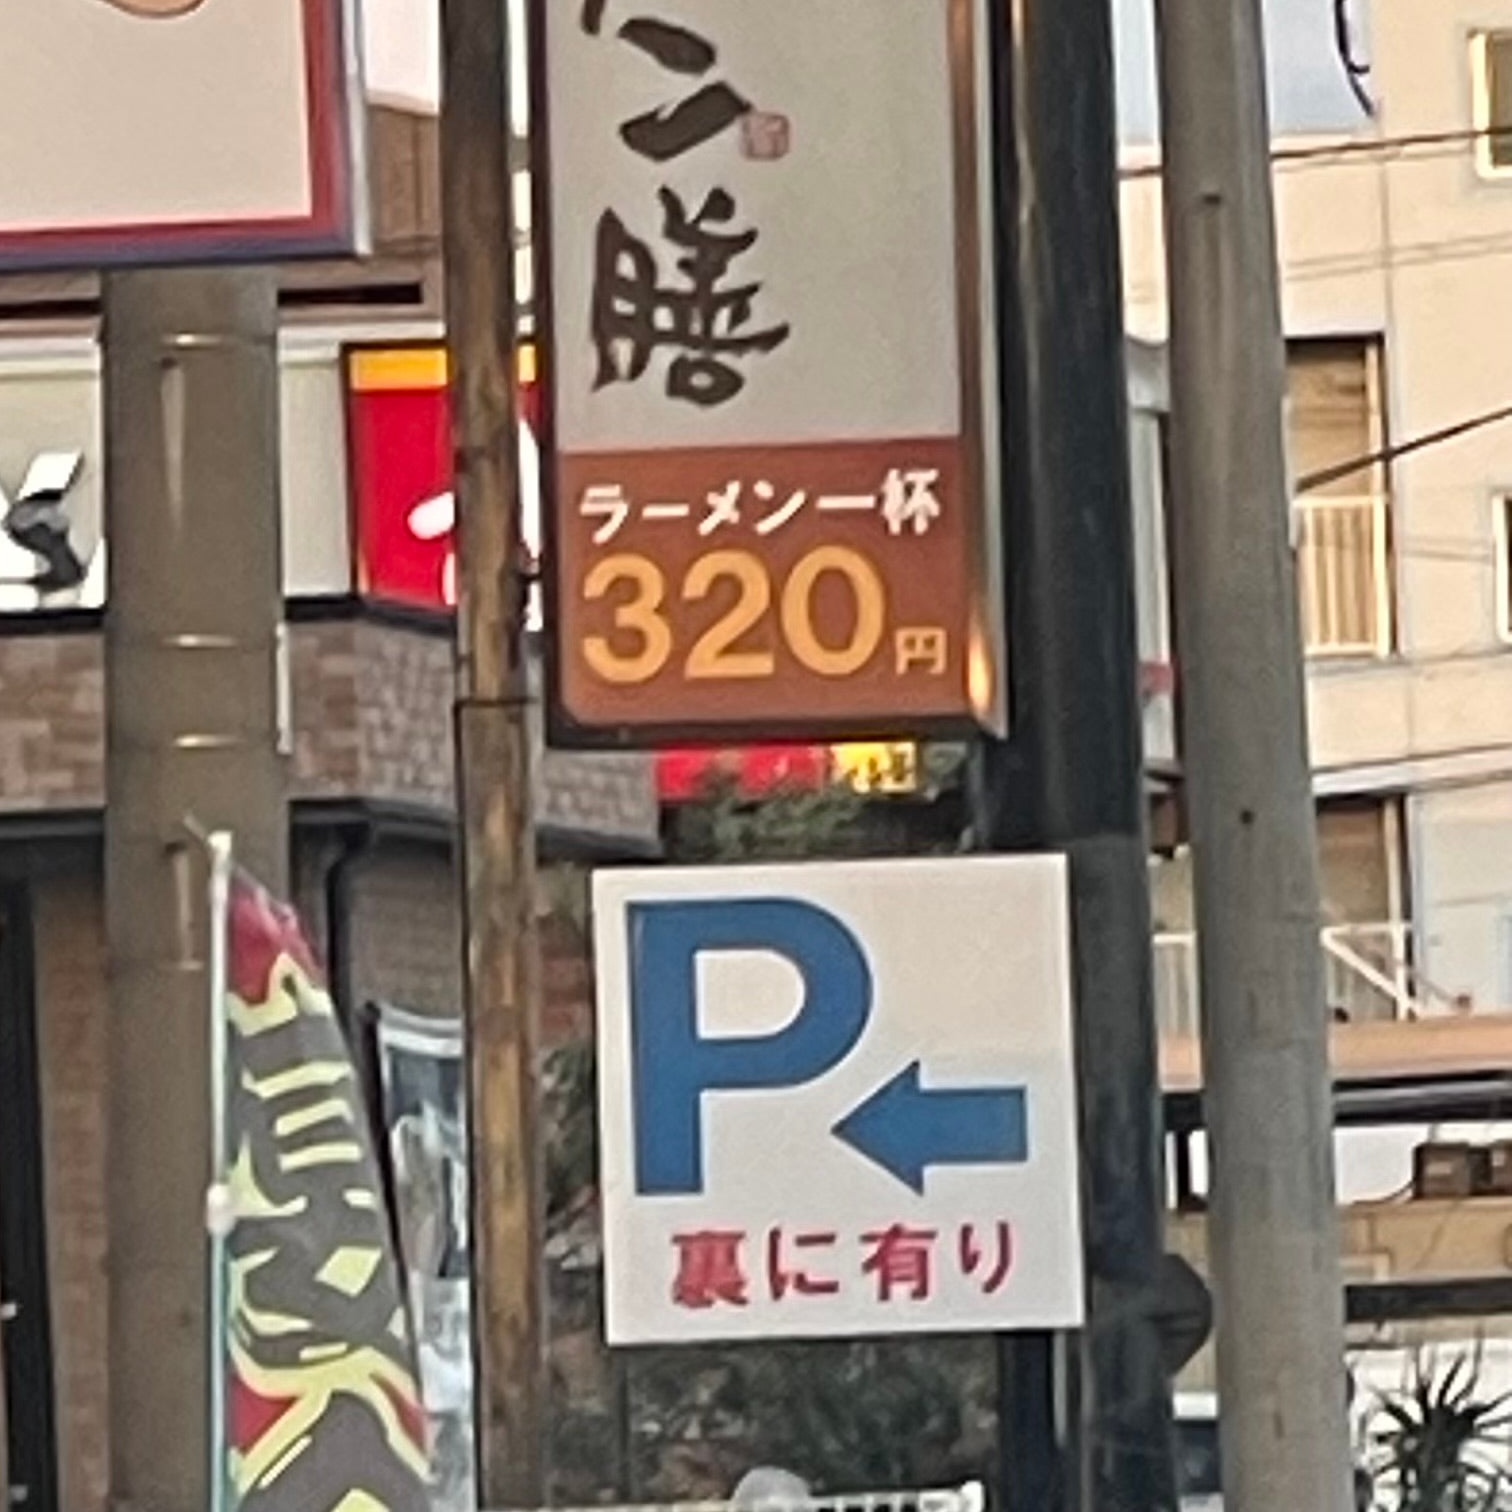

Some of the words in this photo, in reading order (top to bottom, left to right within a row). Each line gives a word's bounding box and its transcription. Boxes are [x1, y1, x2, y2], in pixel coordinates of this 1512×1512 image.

[578, 467, 942, 546] ラーメン一杯
[582, 544, 949, 685] 320円
[625, 896, 874, 1198] P
[670, 1220, 1016, 1311] 裏に有り
